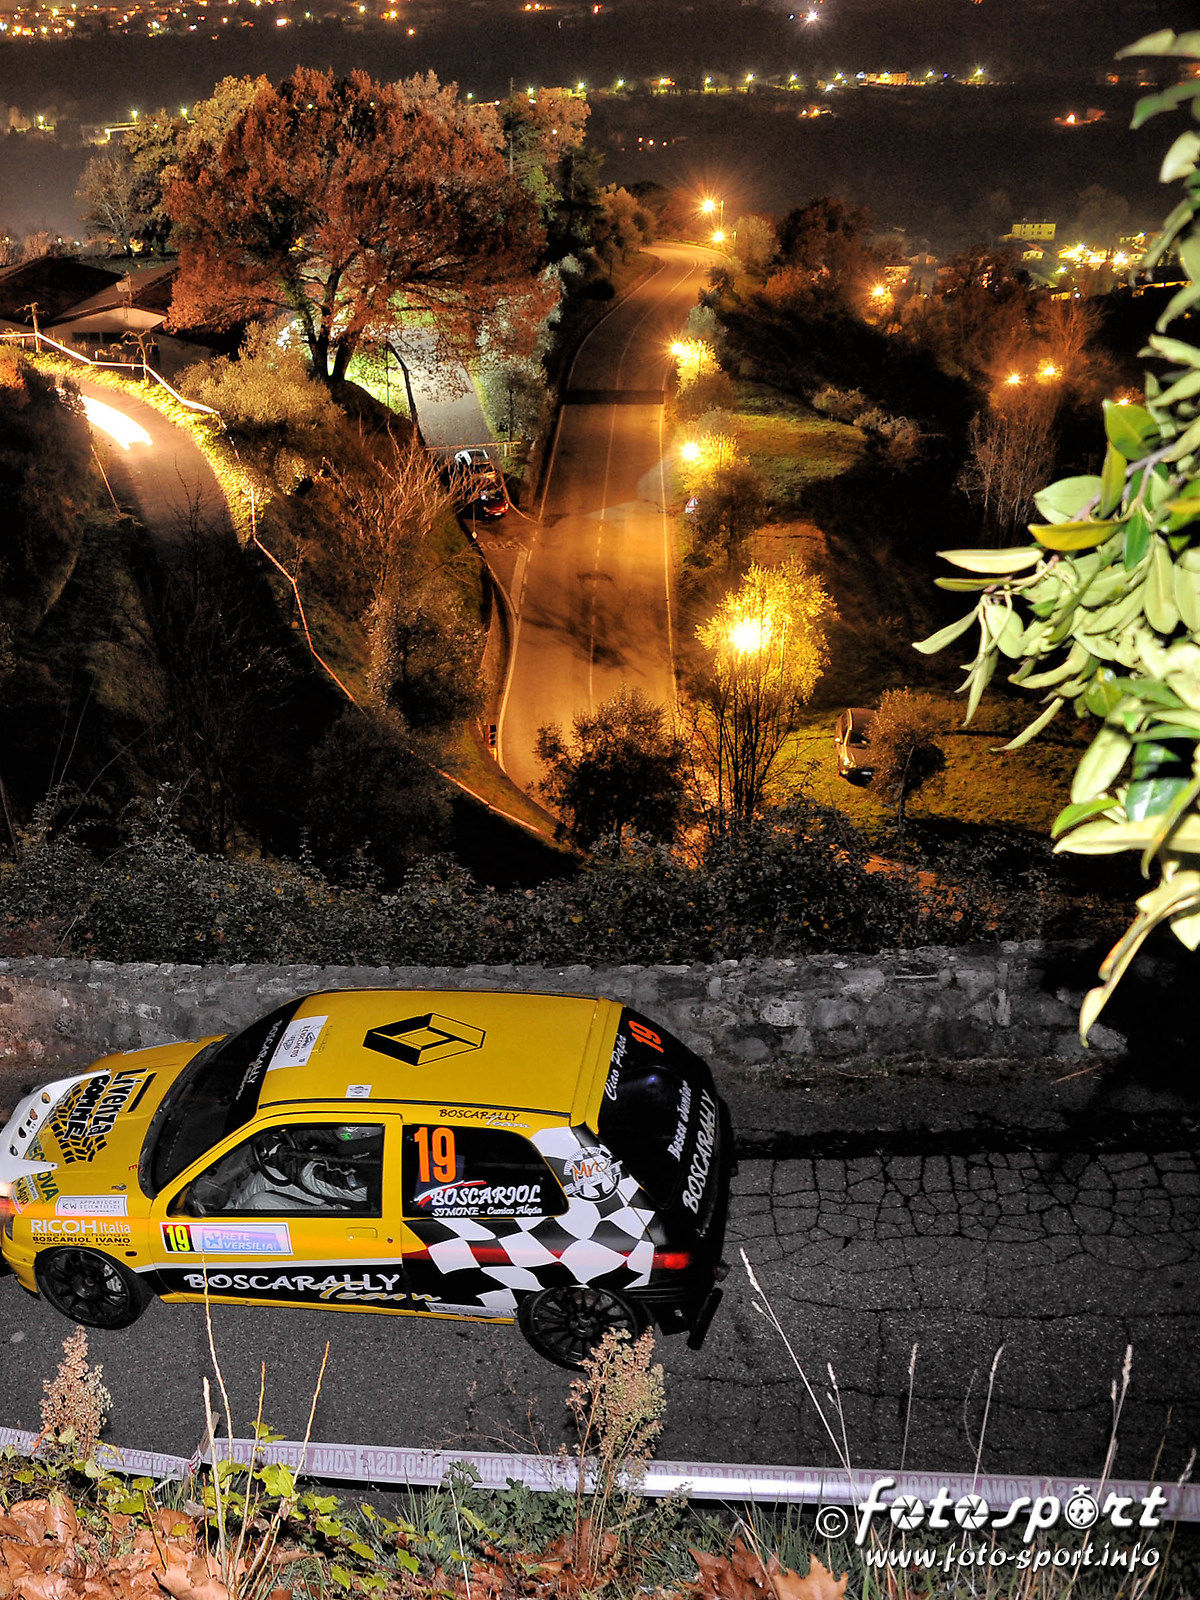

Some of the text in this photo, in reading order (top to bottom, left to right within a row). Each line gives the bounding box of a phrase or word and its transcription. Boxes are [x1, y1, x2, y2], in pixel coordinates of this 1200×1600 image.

[628, 1020, 664, 1053] 19
[604, 1069, 620, 1101] Ciao
[439, 1109, 520, 1122] BOSCARALLY
[414, 1126, 457, 1183] 19
[682, 1088, 716, 1215] BOSCARALLY
[430, 1184, 541, 1206] BOSCARIOL
[432, 1207, 480, 1217] SIMONE
[30, 1219, 132, 1233] RICOH Italia
[166, 1225, 190, 1252] 19
[223, 1241, 274, 1251] VERSILIA
[183, 1273, 400, 1291] BOSCARALLY
